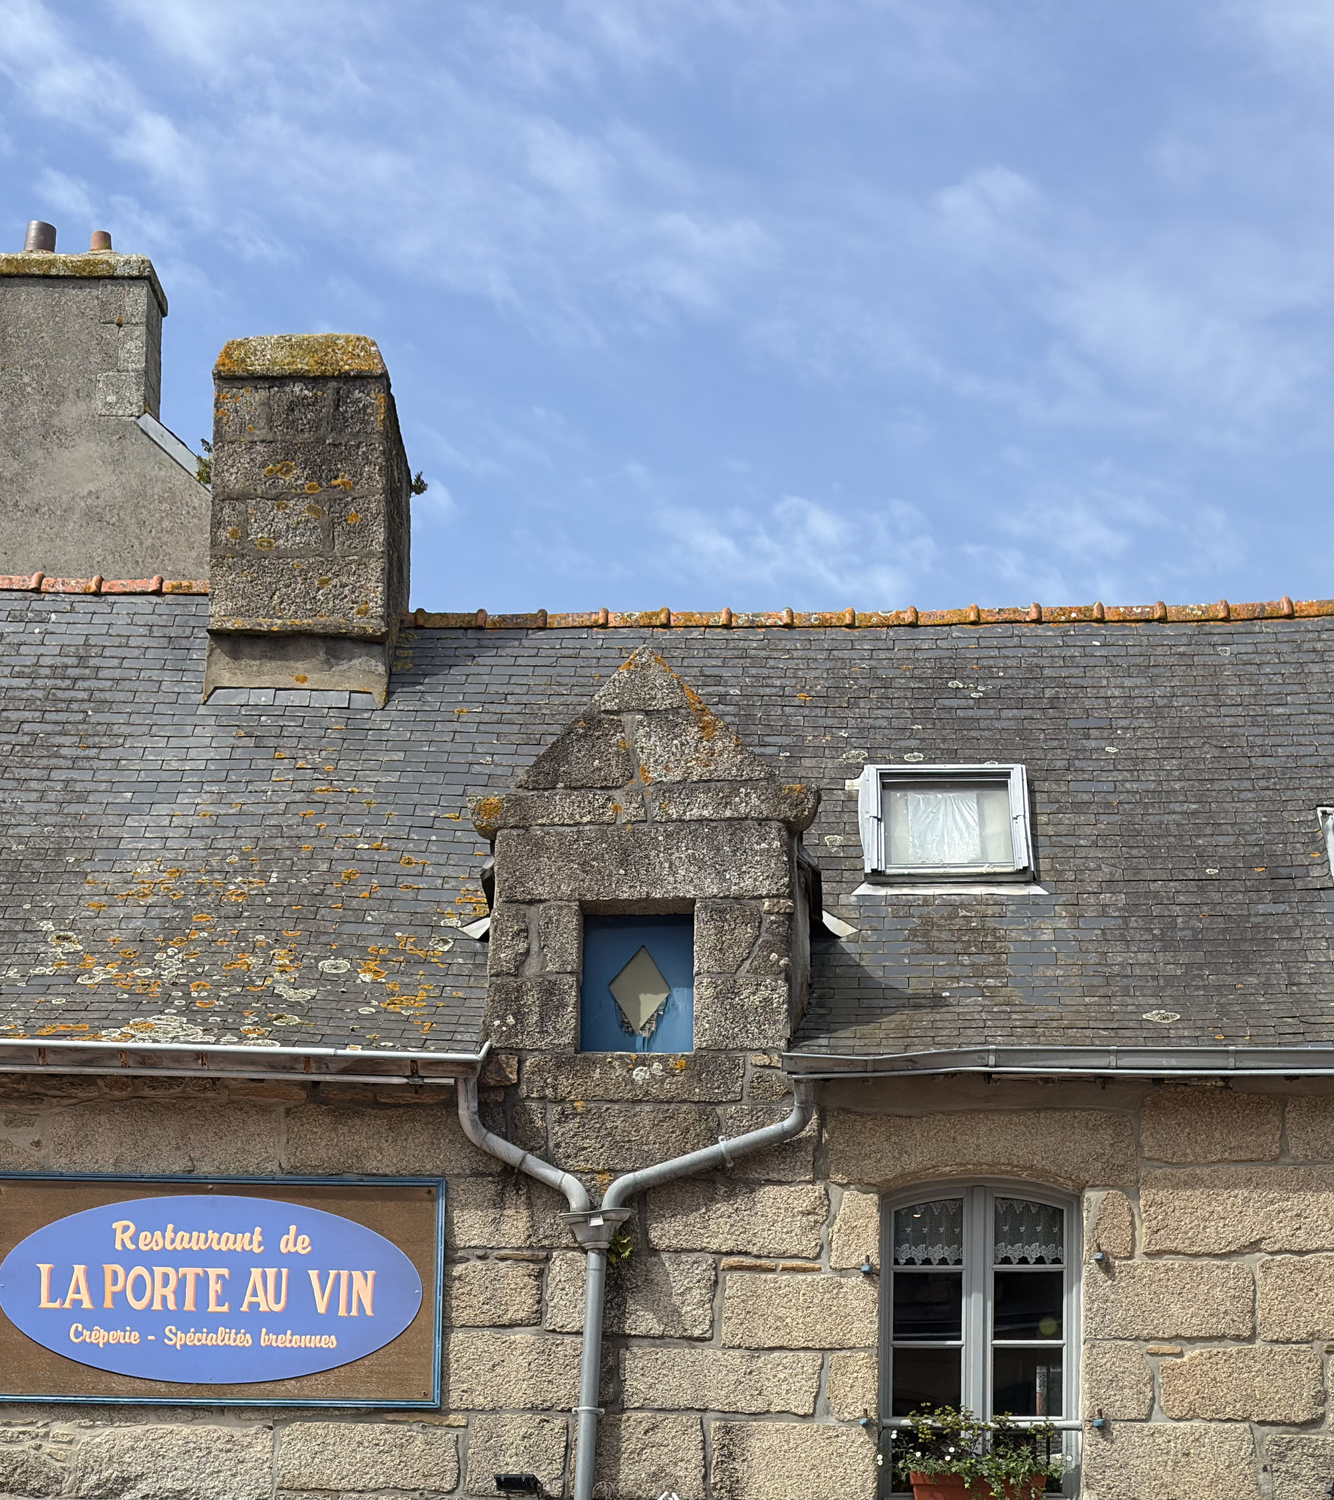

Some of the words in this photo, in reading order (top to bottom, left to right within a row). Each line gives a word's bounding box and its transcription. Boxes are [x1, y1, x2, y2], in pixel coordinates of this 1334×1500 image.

[112, 1220, 264, 1253] Restaurant
[280, 1224, 312, 1255] de
[36, 1263, 94, 1310] LA
[103, 1264, 230, 1312] PORTE
[240, 1267, 290, 1313] AU
[307, 1269, 376, 1317] VIN
[69, 1323, 140, 1348] Crêperie
[163, 1325, 253, 1350] Spécialités
[260, 1328, 338, 1350] bretonnes
